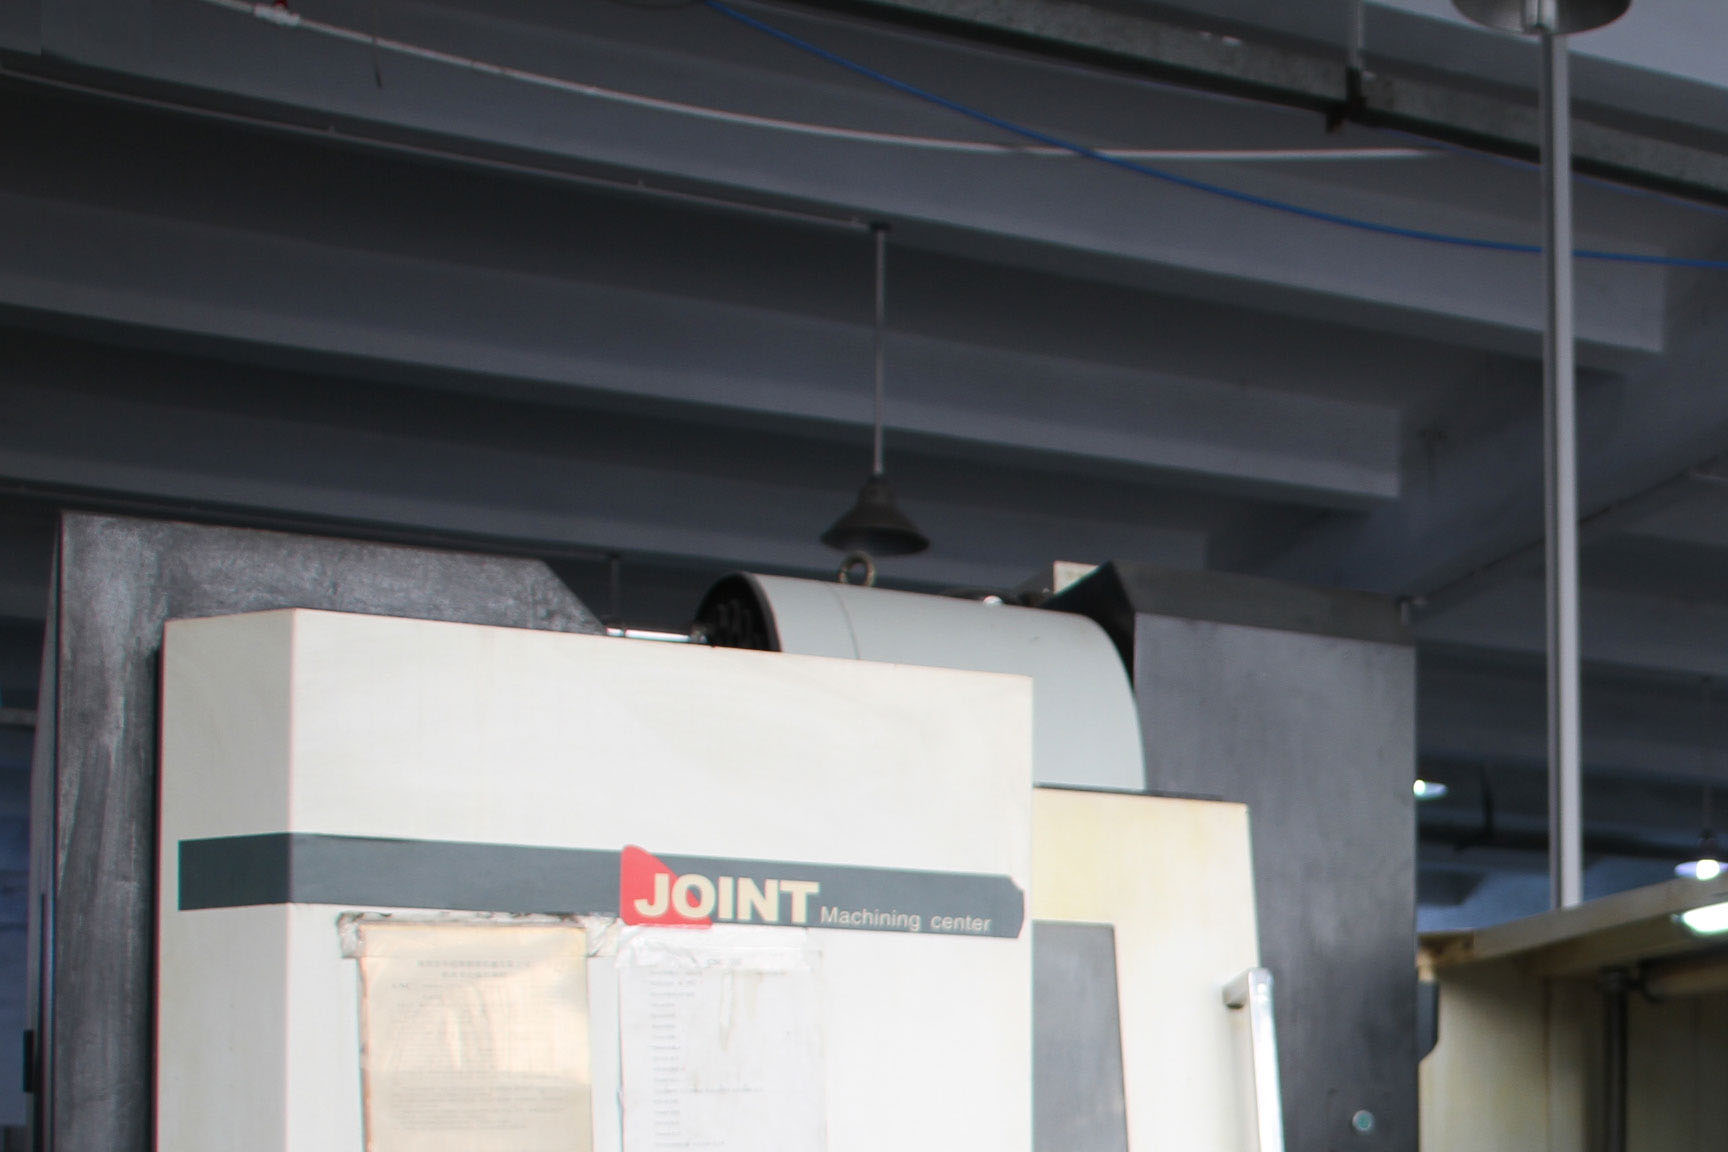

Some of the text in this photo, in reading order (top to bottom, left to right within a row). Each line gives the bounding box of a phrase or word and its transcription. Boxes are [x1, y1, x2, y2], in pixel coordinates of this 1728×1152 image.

[634, 873, 820, 924] JOINT
[820, 905, 992, 932] Machining center
